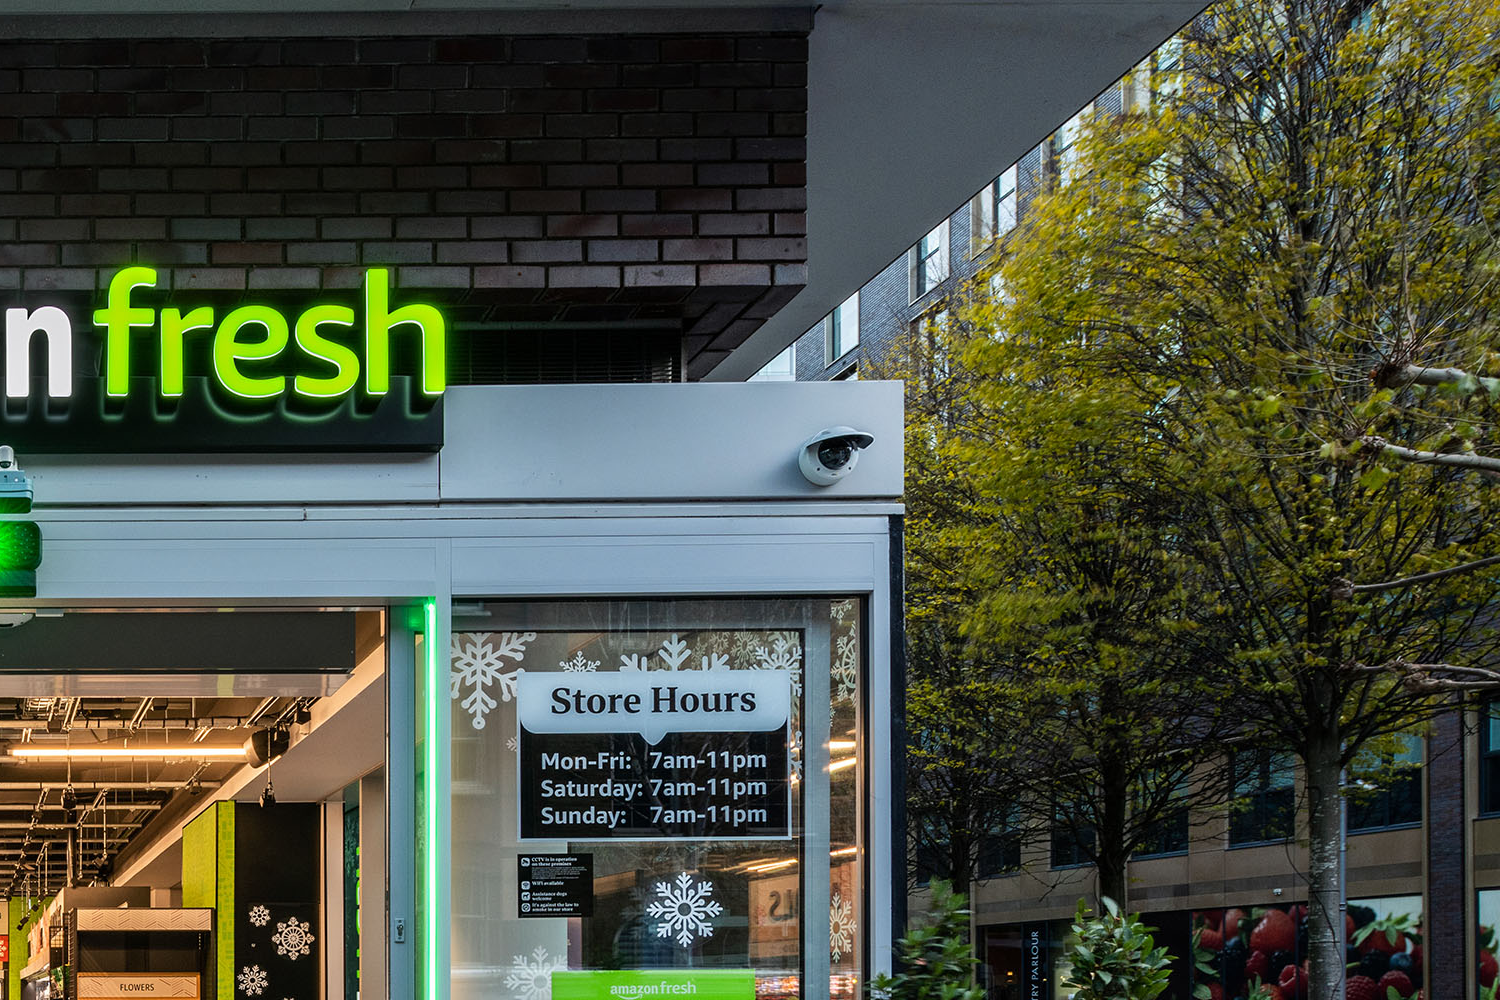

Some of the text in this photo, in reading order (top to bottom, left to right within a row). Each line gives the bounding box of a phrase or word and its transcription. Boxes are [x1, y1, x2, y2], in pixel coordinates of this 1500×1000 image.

[93, 266, 448, 398] fresh
[550, 686, 757, 714] Store Hours
[541, 751, 767, 773] Mon-Fri: 7am-11pm
[541, 779, 767, 801] Saturday: 7am-11pm
[541, 805, 767, 828] Sunday: 7am-11pm
[1031, 931, 1039, 980] PARLOUR
[119, 983, 155, 992] FLOWERS
[610, 981, 697, 995] amazon fresh
